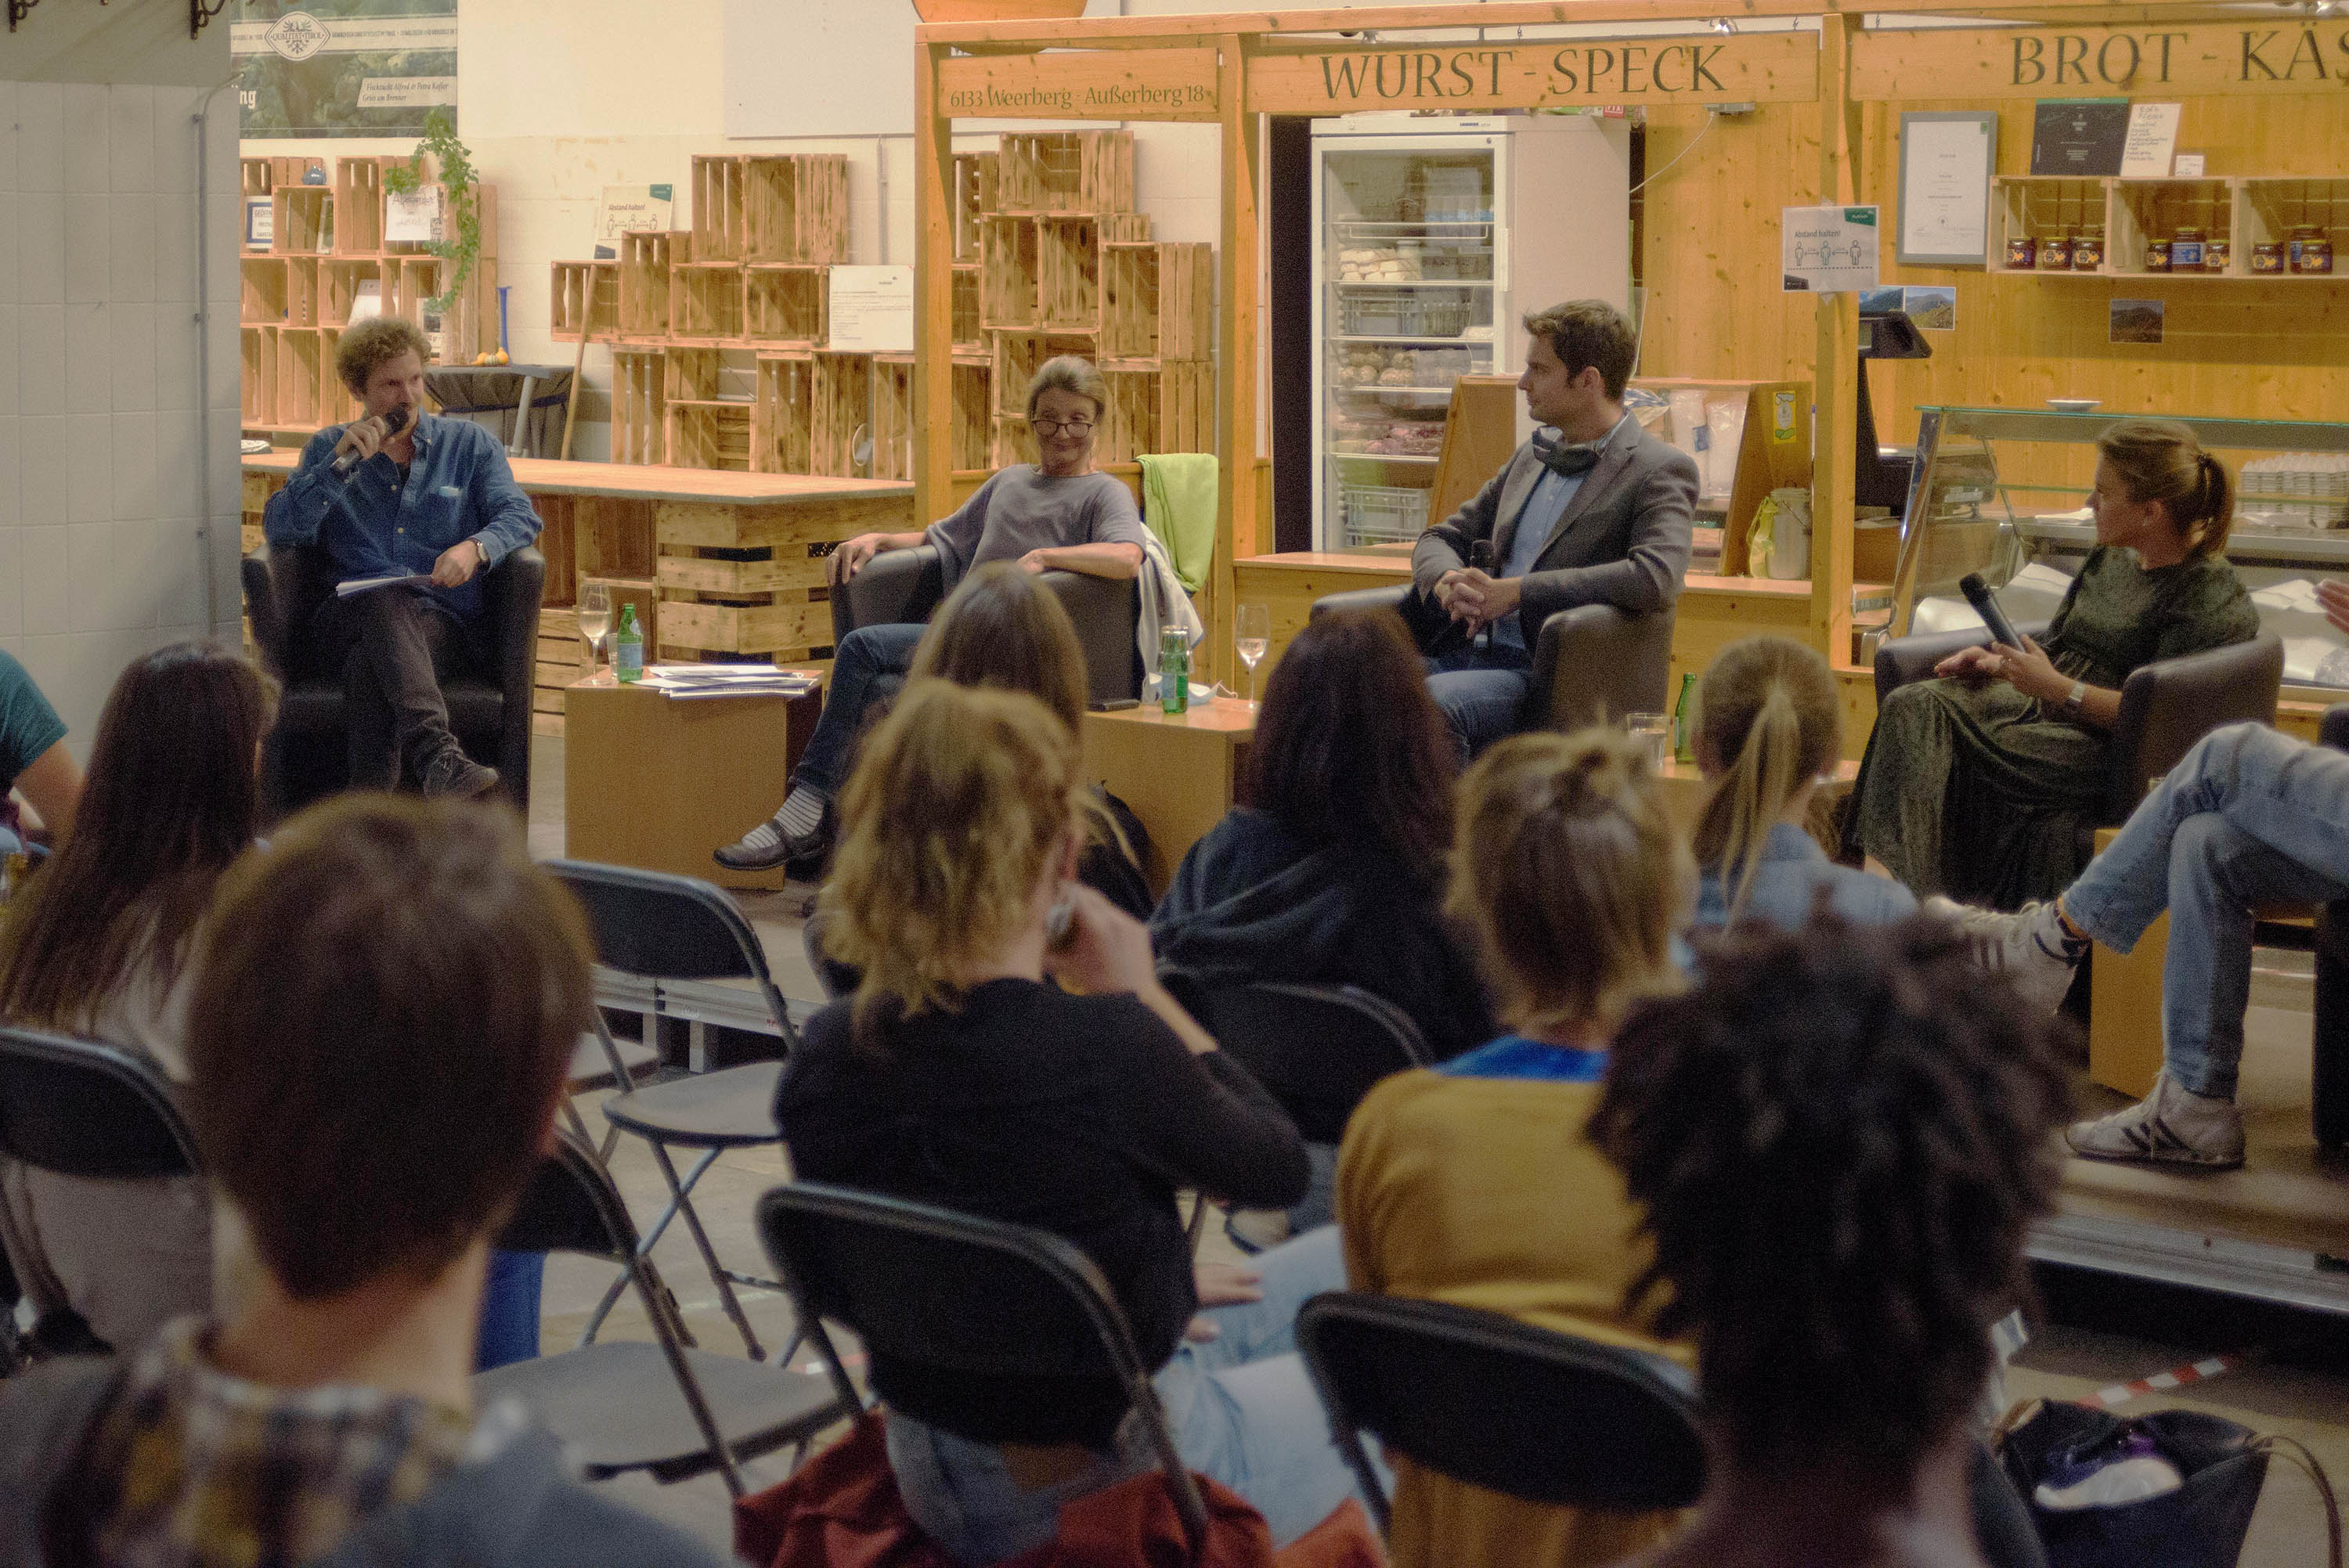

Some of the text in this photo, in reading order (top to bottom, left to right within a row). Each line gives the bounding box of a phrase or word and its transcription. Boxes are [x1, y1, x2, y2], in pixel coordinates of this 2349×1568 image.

[1319, 51, 1513, 99] WURST
[1552, 45, 1727, 94] SPECK
[2010, 33, 2188, 85] BROT
[951, 89, 983, 107] 6133
[987, 85, 1072, 110] Weerberg
[1084, 84, 1183, 107] Außerberg
